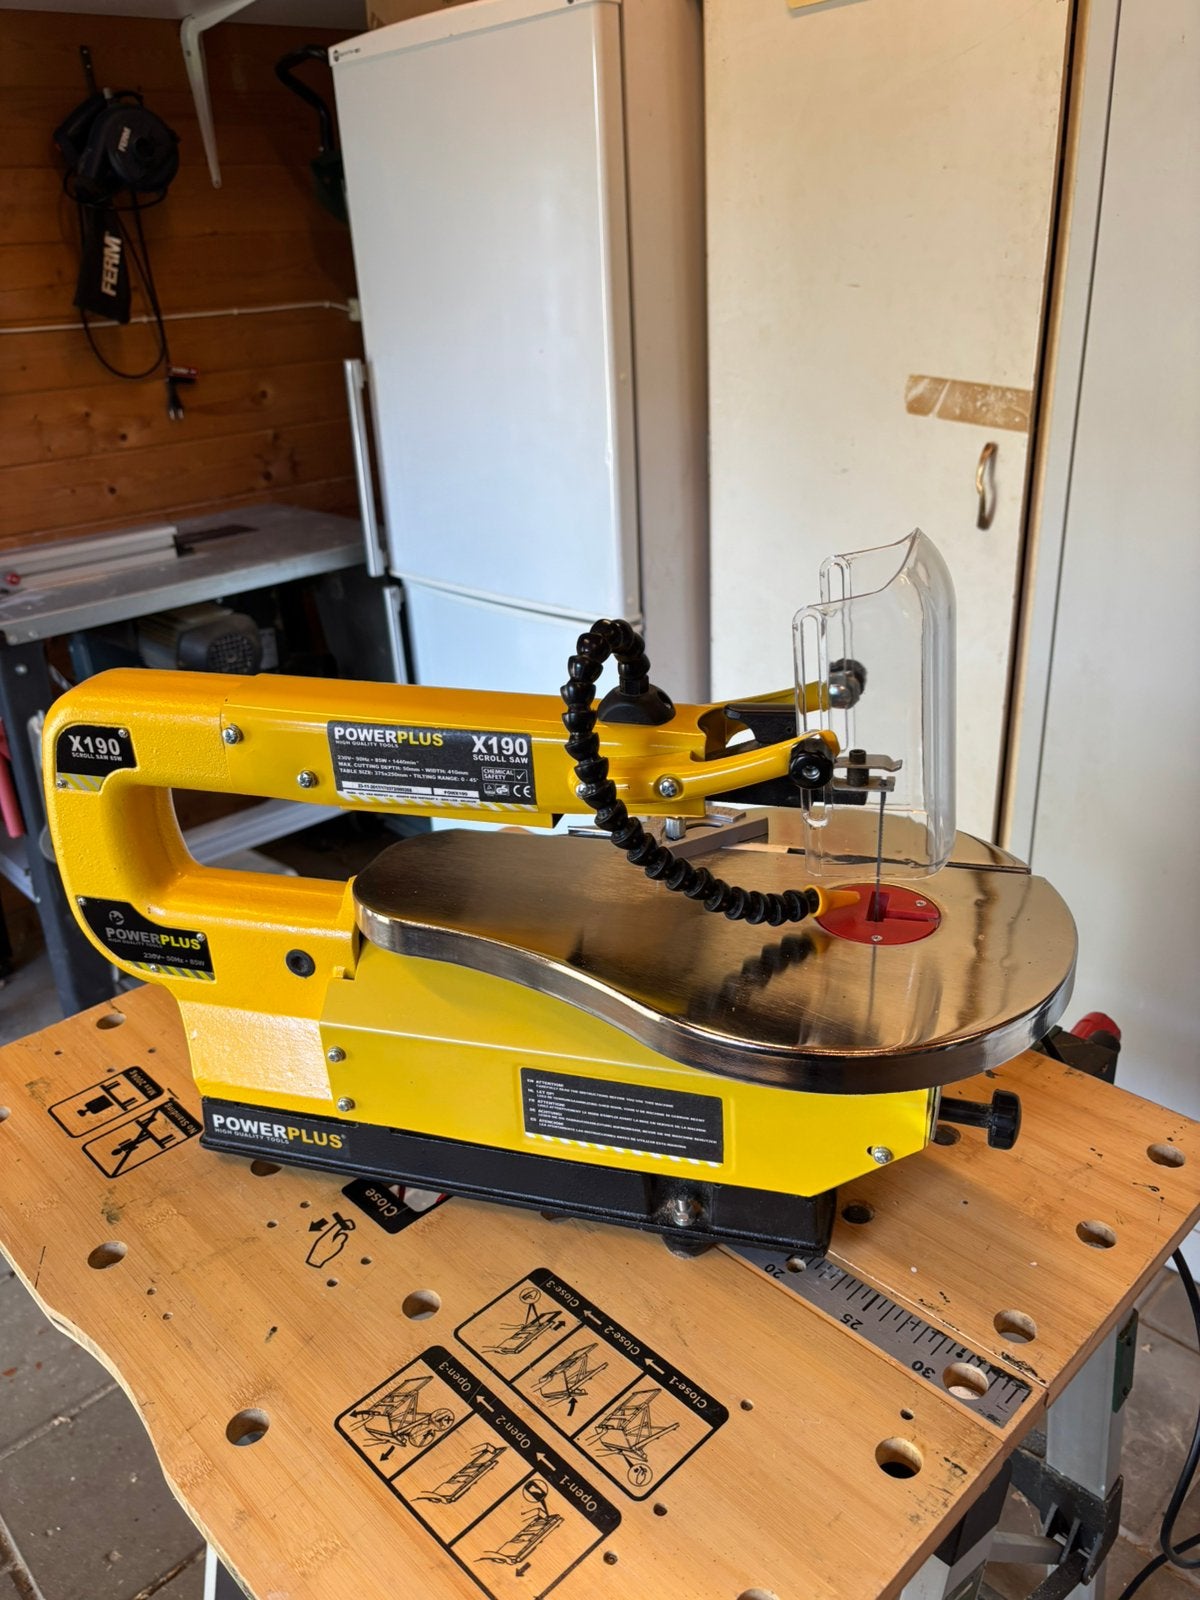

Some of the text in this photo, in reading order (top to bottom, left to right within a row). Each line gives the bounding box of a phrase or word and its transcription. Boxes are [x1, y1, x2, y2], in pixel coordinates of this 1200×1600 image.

[101, 235, 122, 296] FERM
[67, 735, 120, 756] X190
[334, 726, 444, 747] POWERPLUS
[471, 735, 528, 756] X190
[472, 754, 528, 764] SCROLL SAW
[483, 768, 514, 776] CHEMICAL
[105, 927, 201, 950] POWERPLUS
[164, 1102, 198, 1135] No Standing
[212, 1113, 343, 1149] POWERPLUS
[214, 1127, 290, 1145] HIGH QUALITY TOOLS
[364, 1187, 398, 1217] Close
[764, 1262, 786, 1279] 20
[545, 1280, 580, 1308] Close-3
[840, 1313, 863, 1331] 25
[603, 1325, 641, 1356] Close-2
[438, 1361, 472, 1392] Open-3
[911, 1360, 936, 1380] 30
[668, 1375, 708, 1409] Close-1
[495, 1414, 531, 1449] Open-2
[558, 1475, 598, 1512] Open-1
